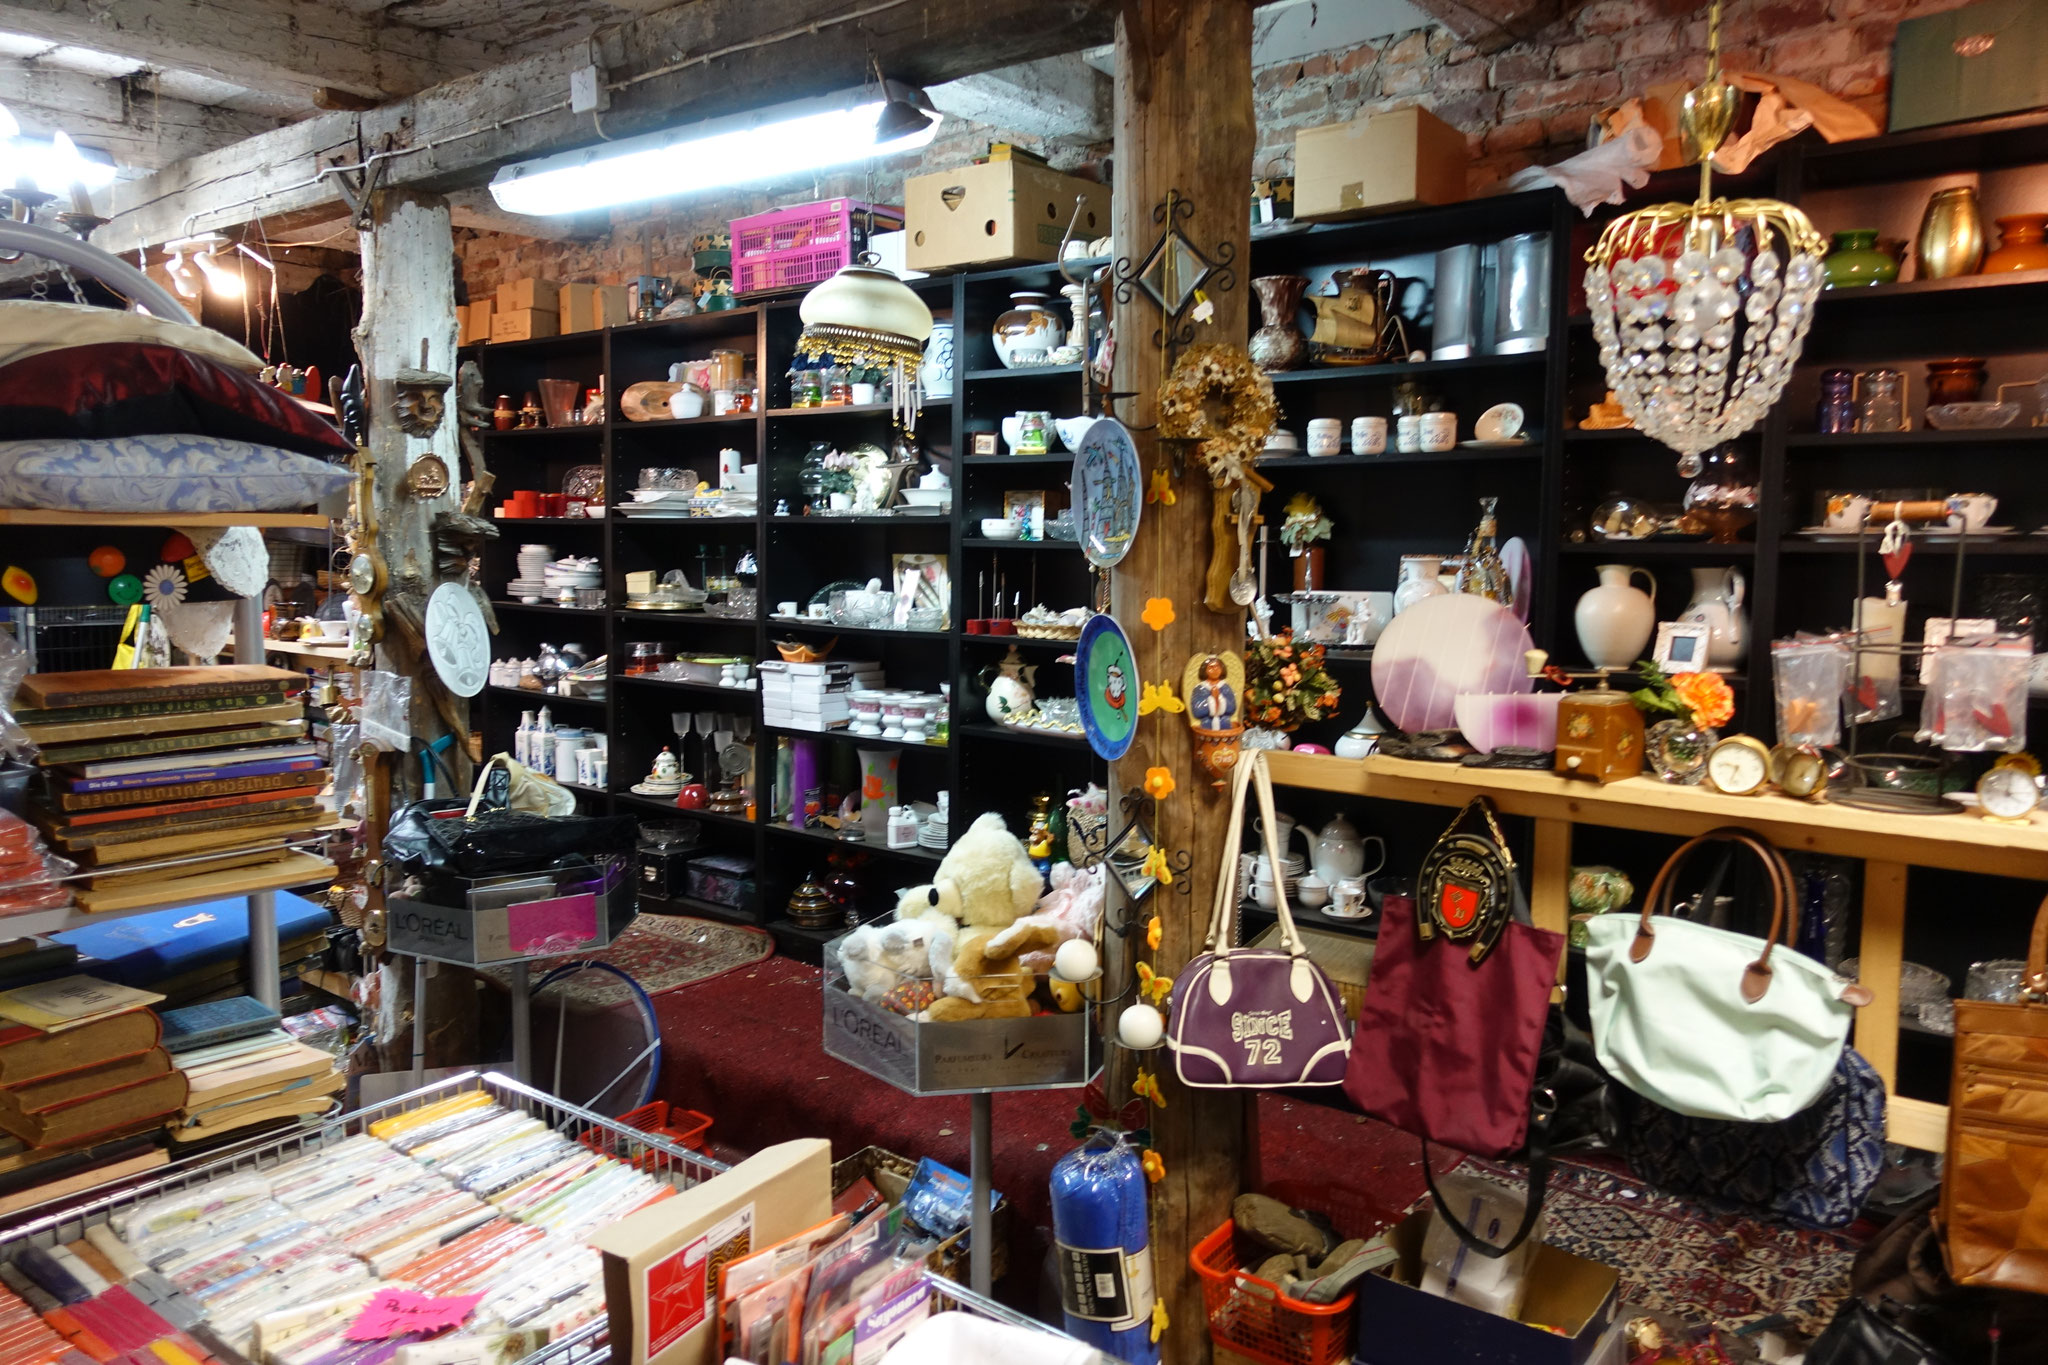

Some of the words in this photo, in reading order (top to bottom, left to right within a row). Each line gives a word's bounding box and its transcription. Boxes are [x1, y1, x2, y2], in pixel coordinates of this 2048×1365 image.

[181, 686, 206, 697] DER
[81, 784, 209, 806] KULTURBILDER
[209, 776, 281, 791] DEUTSCHE
[394, 912, 468, 941] L'ORÉAL
[1231, 1009, 1293, 1043] SINCE
[1244, 1039, 1282, 1066] 72
